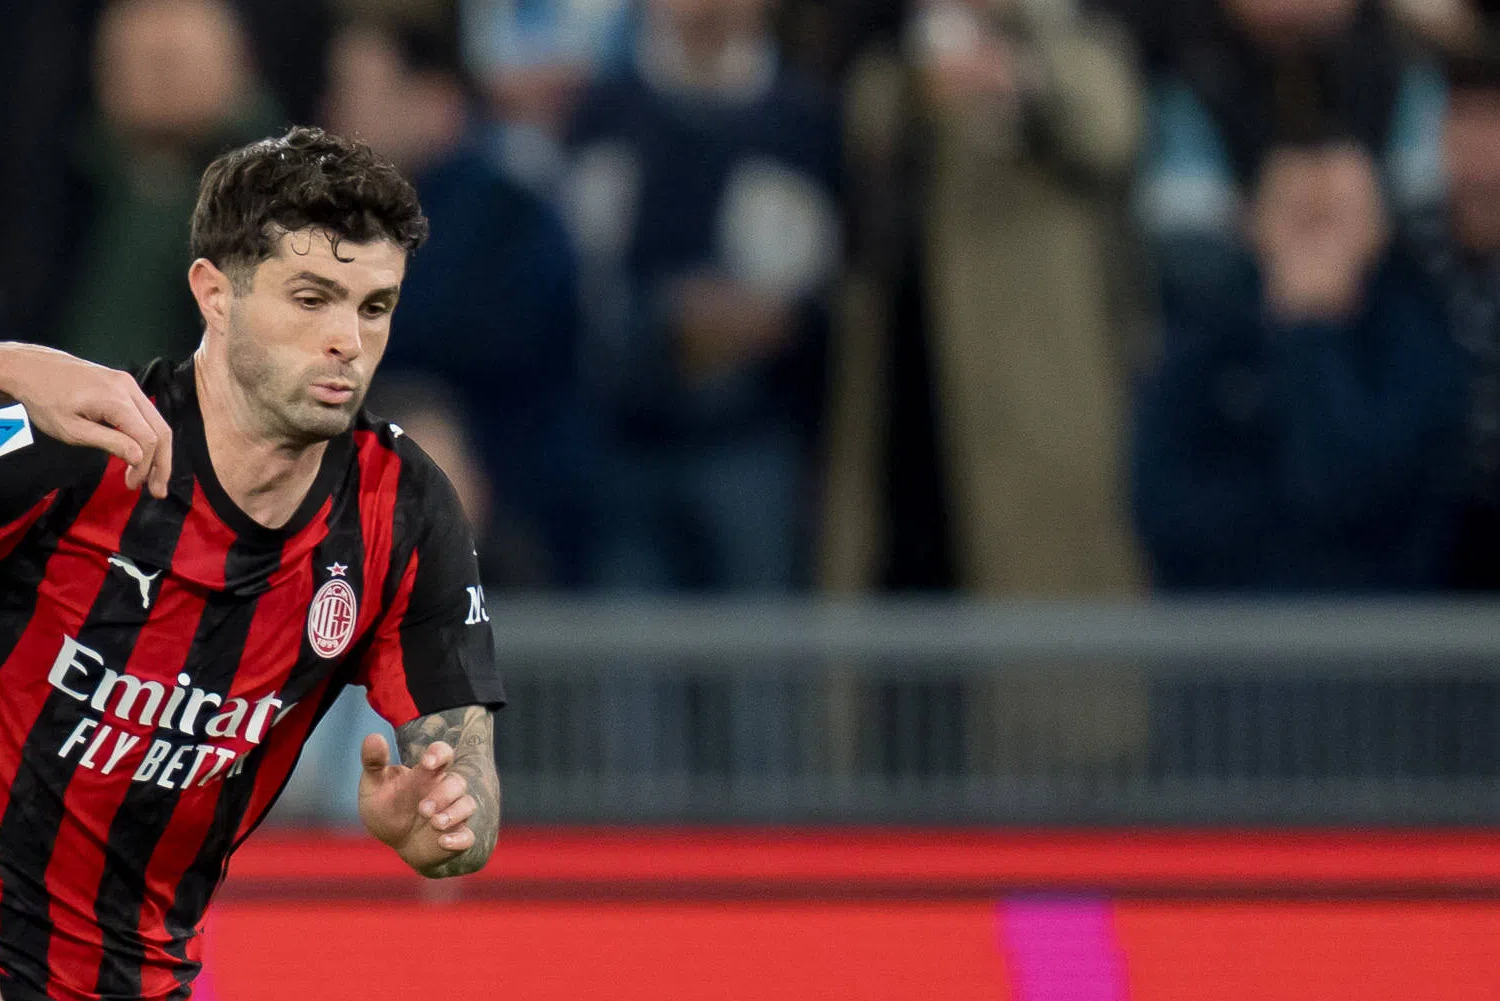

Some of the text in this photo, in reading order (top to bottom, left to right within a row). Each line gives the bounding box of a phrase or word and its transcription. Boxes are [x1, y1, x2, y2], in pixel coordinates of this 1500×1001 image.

[47, 633, 299, 744] Emirat
[57, 717, 250, 789] FLY BETT
